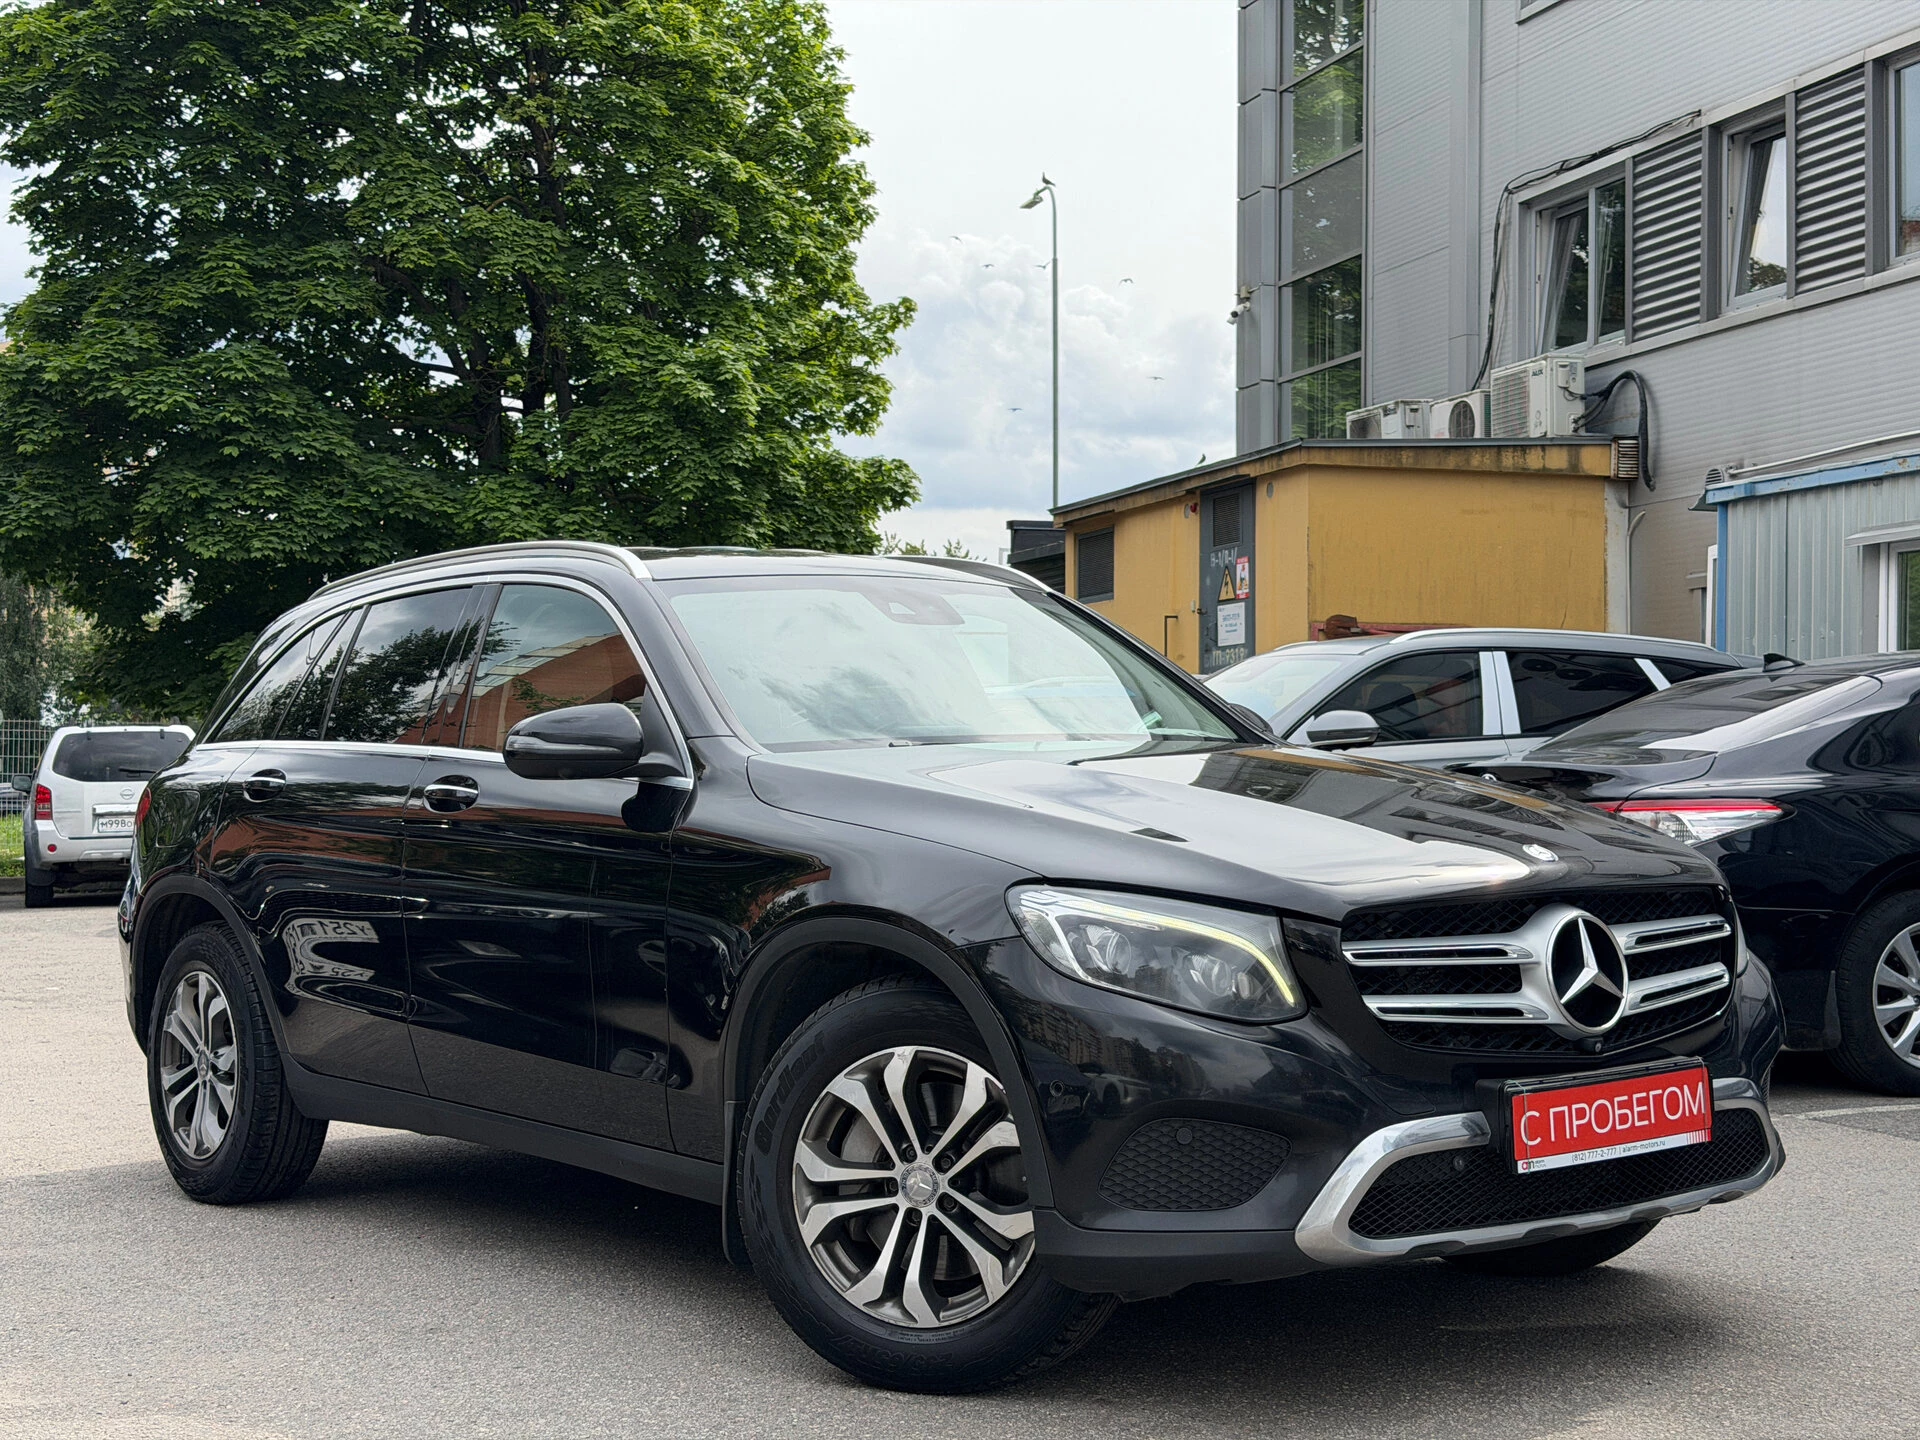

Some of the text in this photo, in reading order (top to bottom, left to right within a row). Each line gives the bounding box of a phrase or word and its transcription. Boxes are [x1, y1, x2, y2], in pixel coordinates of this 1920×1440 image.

[1520, 1081, 1706, 1146] С ПРОБЕГОМ
[1571, 1139, 1666, 1163] (812) 777-2-777 alarm-motors.ru
